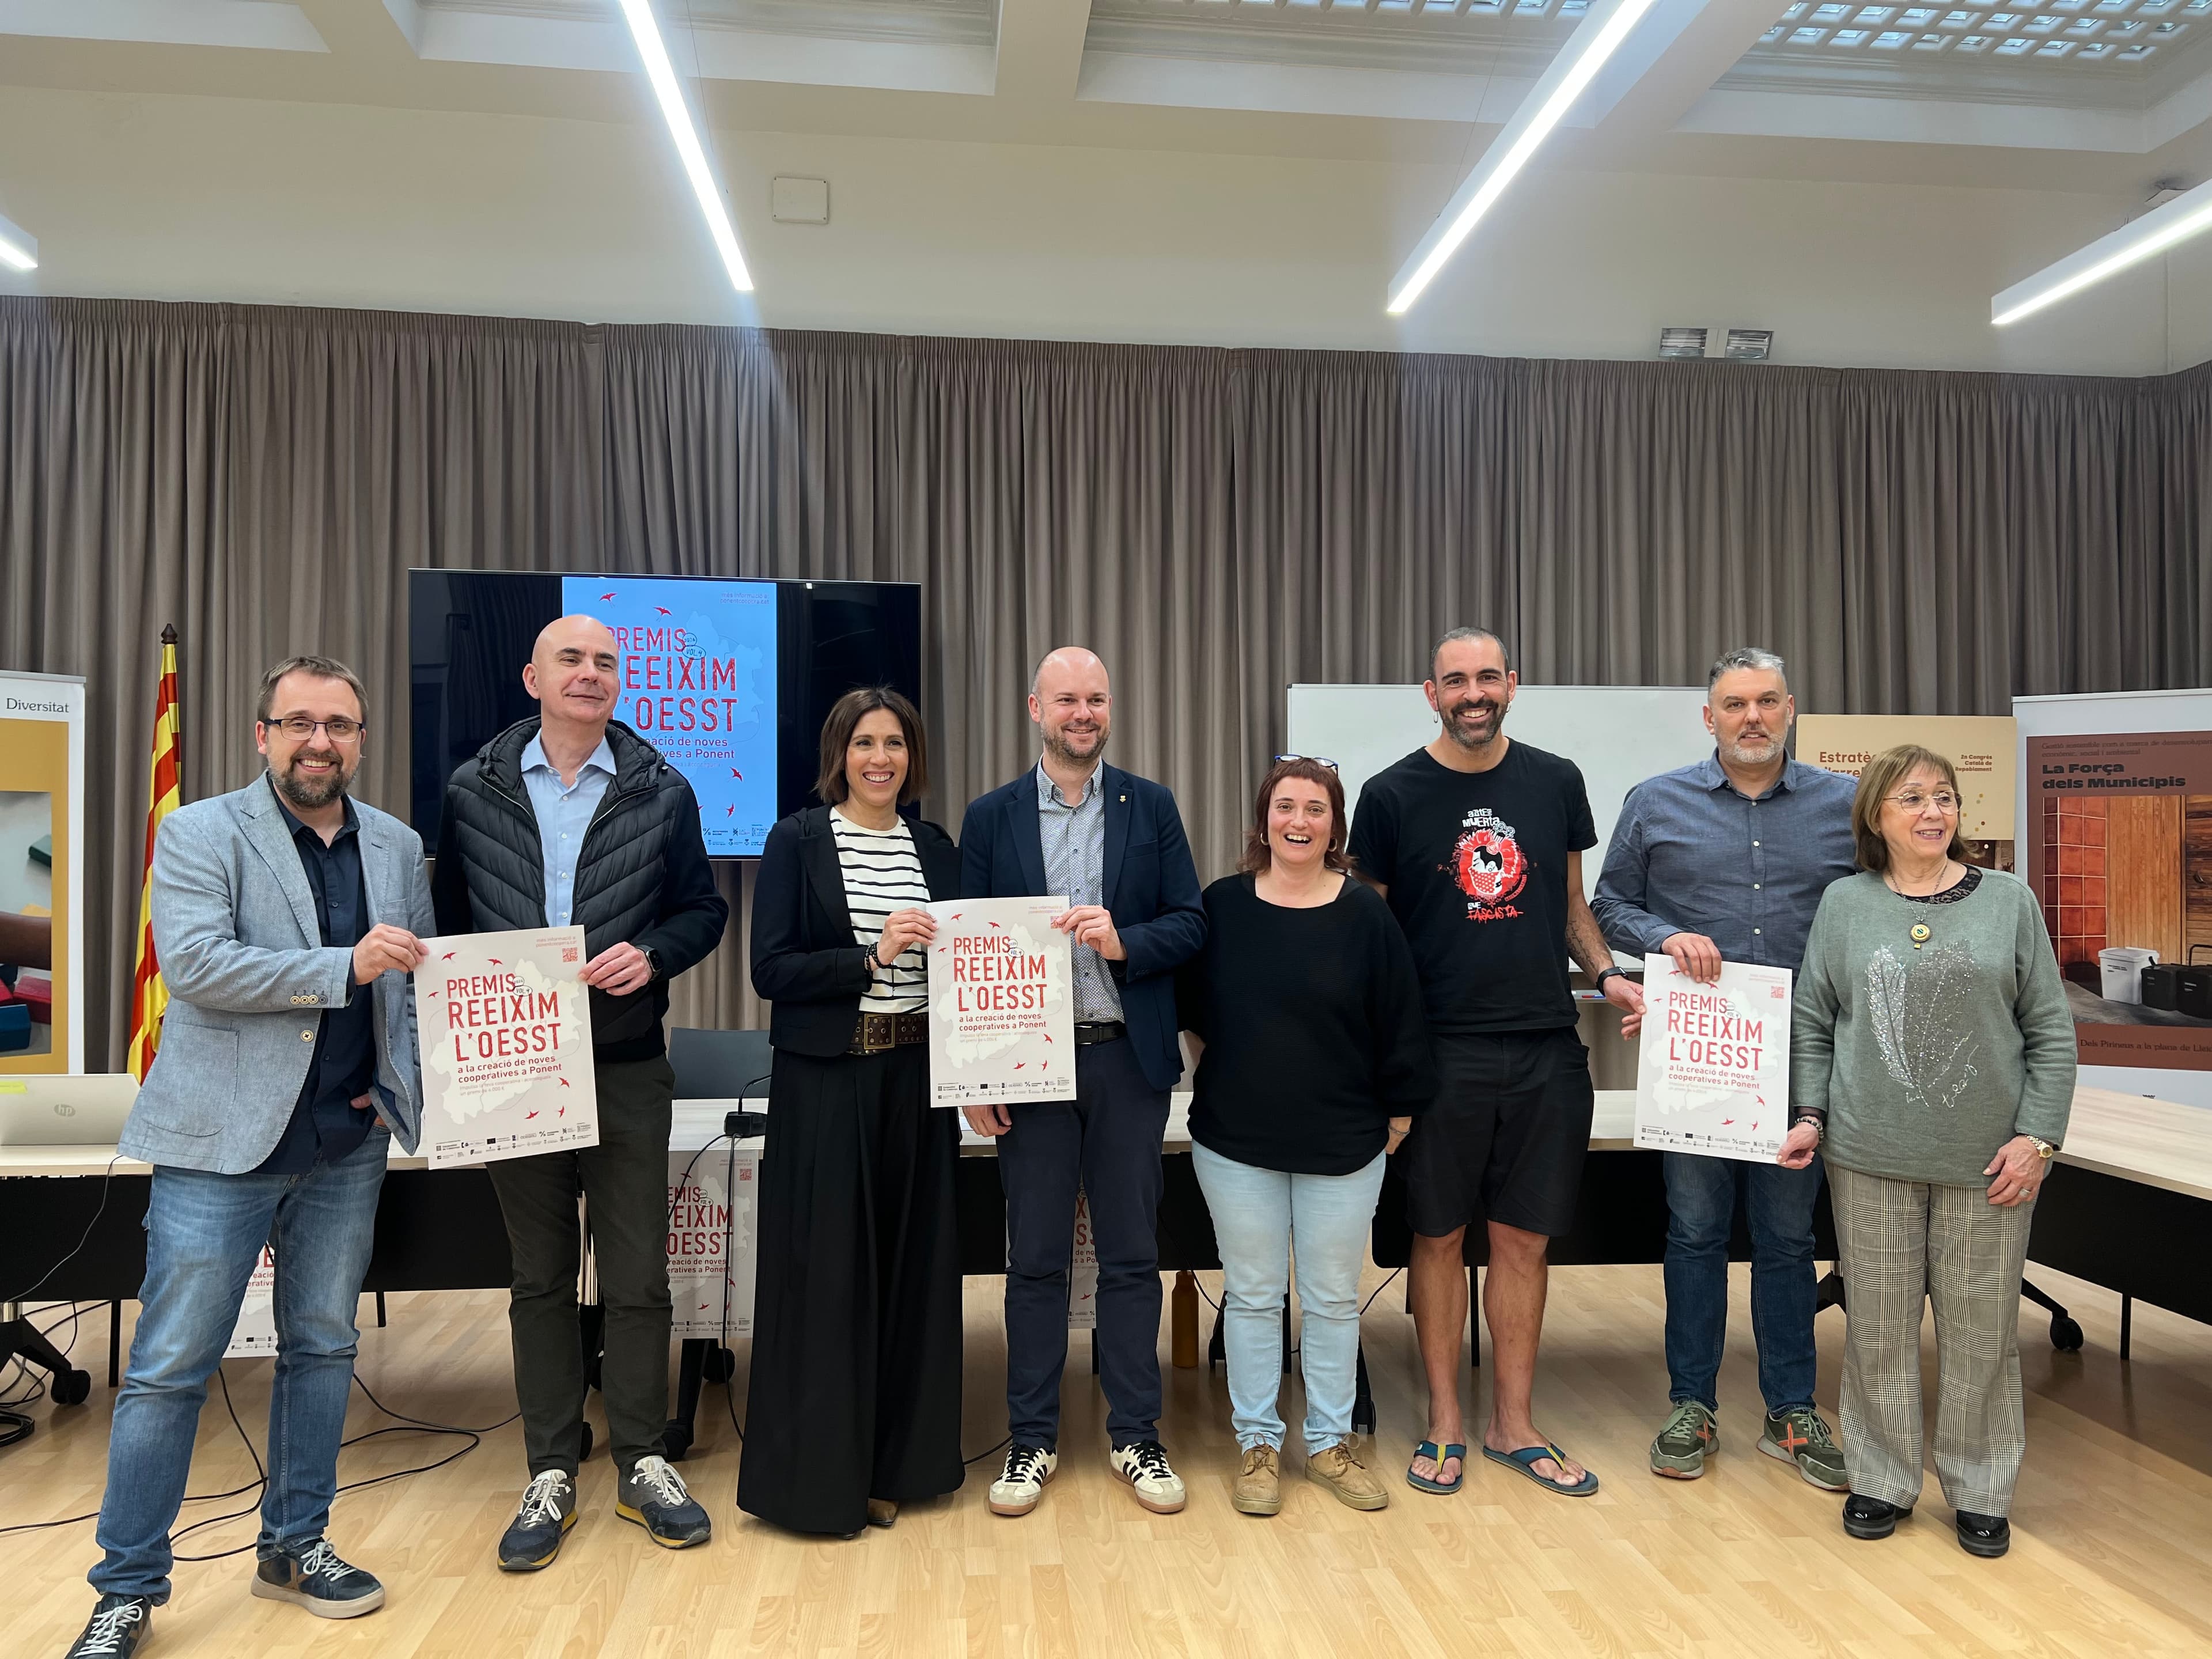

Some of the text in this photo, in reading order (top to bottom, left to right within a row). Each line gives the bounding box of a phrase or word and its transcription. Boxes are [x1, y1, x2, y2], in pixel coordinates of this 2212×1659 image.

[626, 655, 736, 691] EEIXIM
[6, 698, 70, 713] Diversitat
[624, 696, 738, 732] 'OESST
[646, 736, 728, 747] eació de noves
[695, 749, 734, 759] Ponent
[1819, 751, 1872, 763] Estratè
[2042, 763, 2124, 776] La Força
[2042, 777, 2187, 789] dels Municipis
[953, 935, 1010, 955] PREMIS
[953, 954, 1046, 982] REEIXIM
[446, 973, 516, 999] PREMIS
[957, 983, 1047, 1012] L'OESST
[1669, 990, 1728, 1014] PREMIS
[448, 991, 559, 1029] REEIXIM
[975, 1013, 1004, 1021] creació
[959, 1022, 1010, 1032] cooperatives
[1668, 1009, 1763, 1044] REEIXIM
[454, 1022, 561, 1062] L'OESST
[2080, 1039, 2099, 1047] Dels
[2100, 1040, 2134, 1049] Pirineus
[2144, 1041, 2152, 1050] la
[2154, 1043, 2177, 1051] plana
[1669, 1037, 1763, 1071] L'OESST
[477, 1059, 512, 1071] creació
[514, 1058, 525, 1066] de
[528, 1056, 556, 1065] noves
[458, 1069, 519, 1083] cooperatives
[529, 1063, 562, 1074] Ponent
[1668, 1073, 1722, 1085] cooperatives
[1730, 1079, 1760, 1089] Ponent
[1686, 1066, 1716, 1075] creació
[1731, 1072, 1756, 1081] noves
[57, 1104, 73, 1117] hp
[673, 1205, 733, 1228] EIXIM
[668, 1257, 691, 1266] reació
